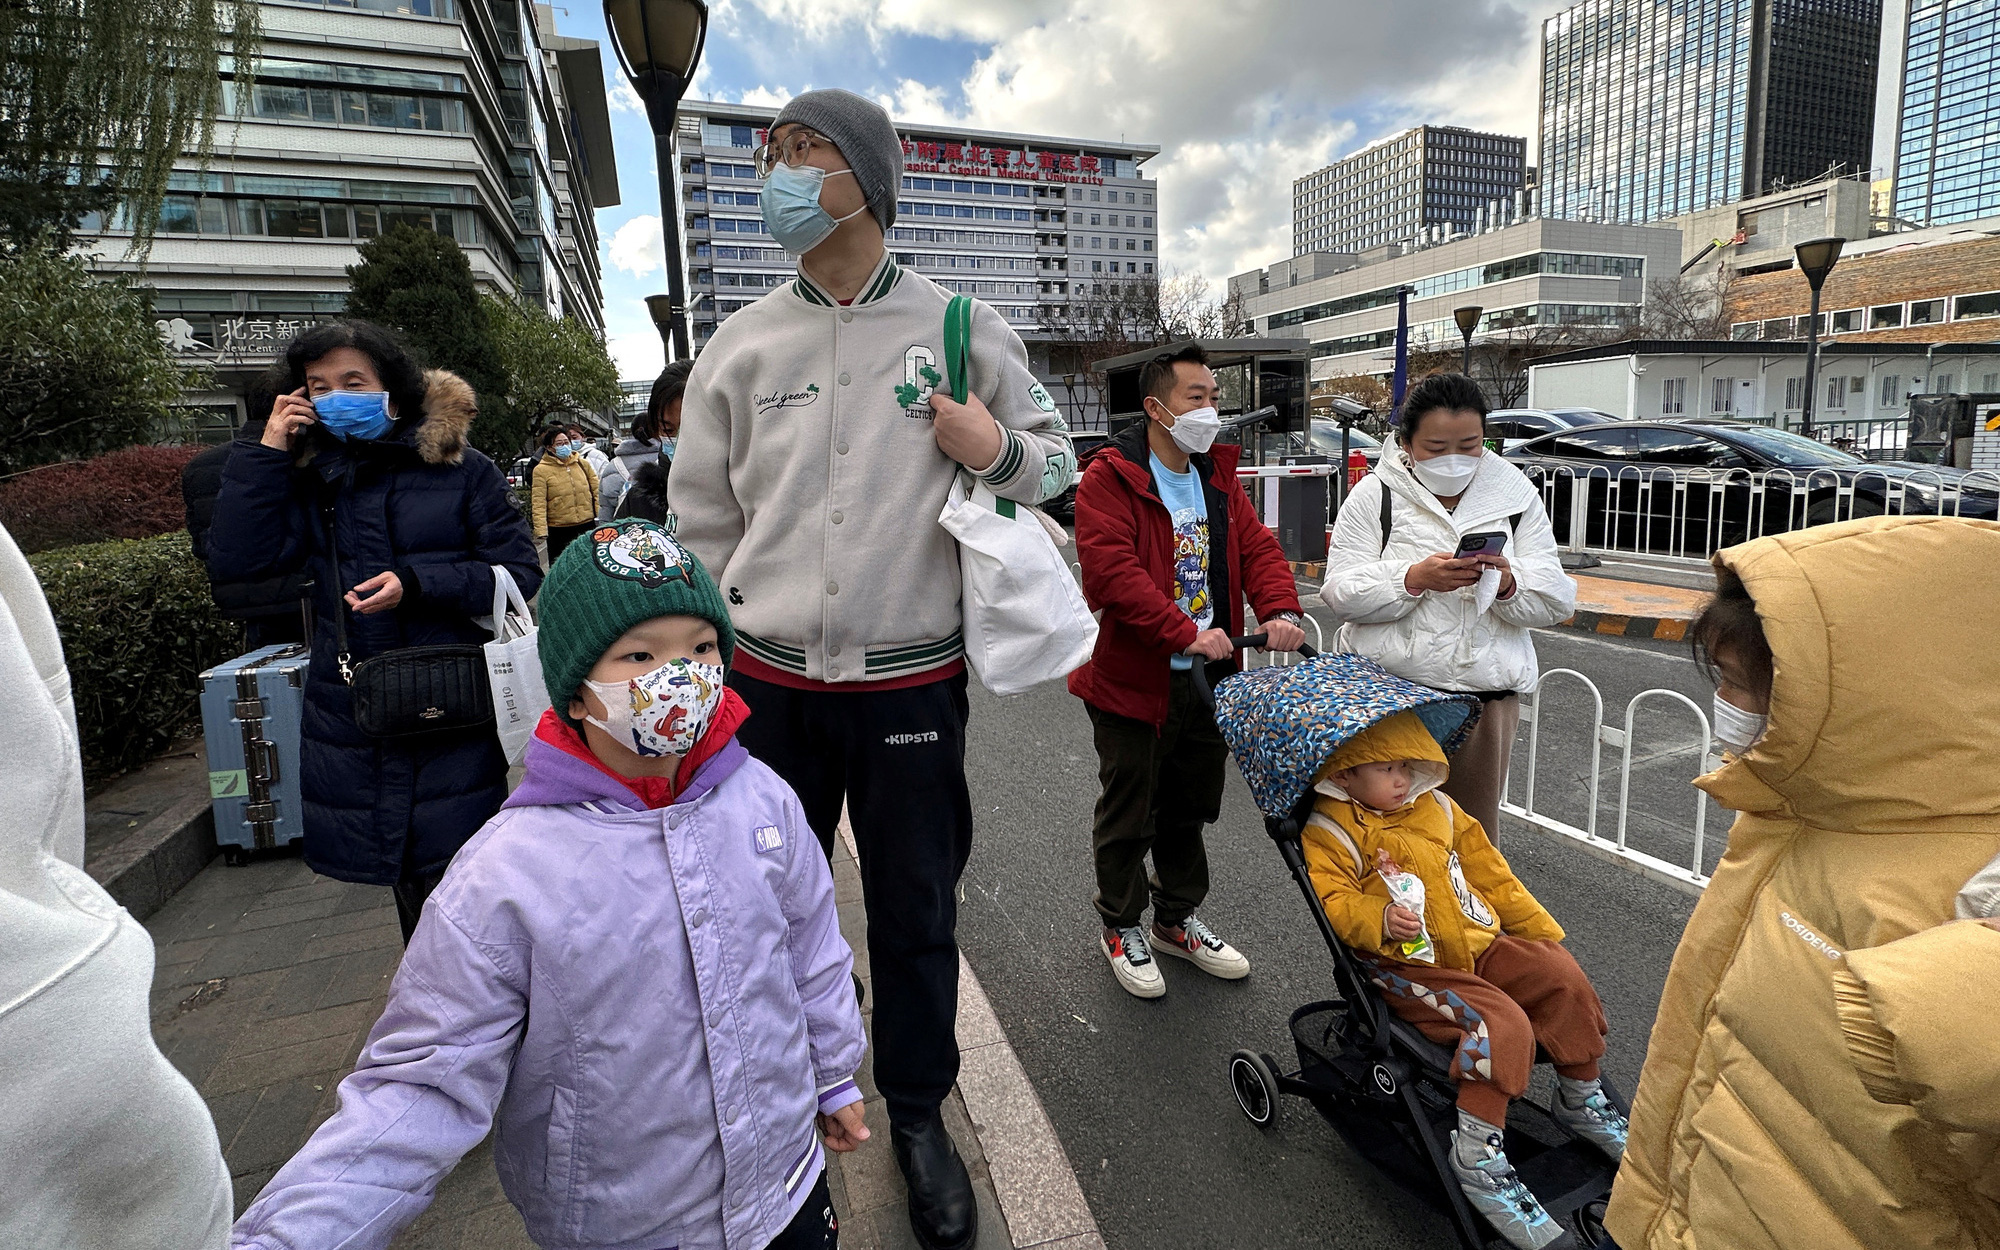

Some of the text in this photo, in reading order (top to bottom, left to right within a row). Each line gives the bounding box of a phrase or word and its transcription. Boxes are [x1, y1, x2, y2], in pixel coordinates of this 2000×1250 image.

[949, 164, 991, 177] Capital
[997, 167, 1040, 181] Medical
[1046, 173, 1104, 187] University
[223, 343, 247, 353] New
[905, 408, 932, 421] CELTICS
[597, 543, 631, 576] BOSTON
[763, 825, 783, 849] NBA
[1780, 911, 1842, 960] BOSIDENG
